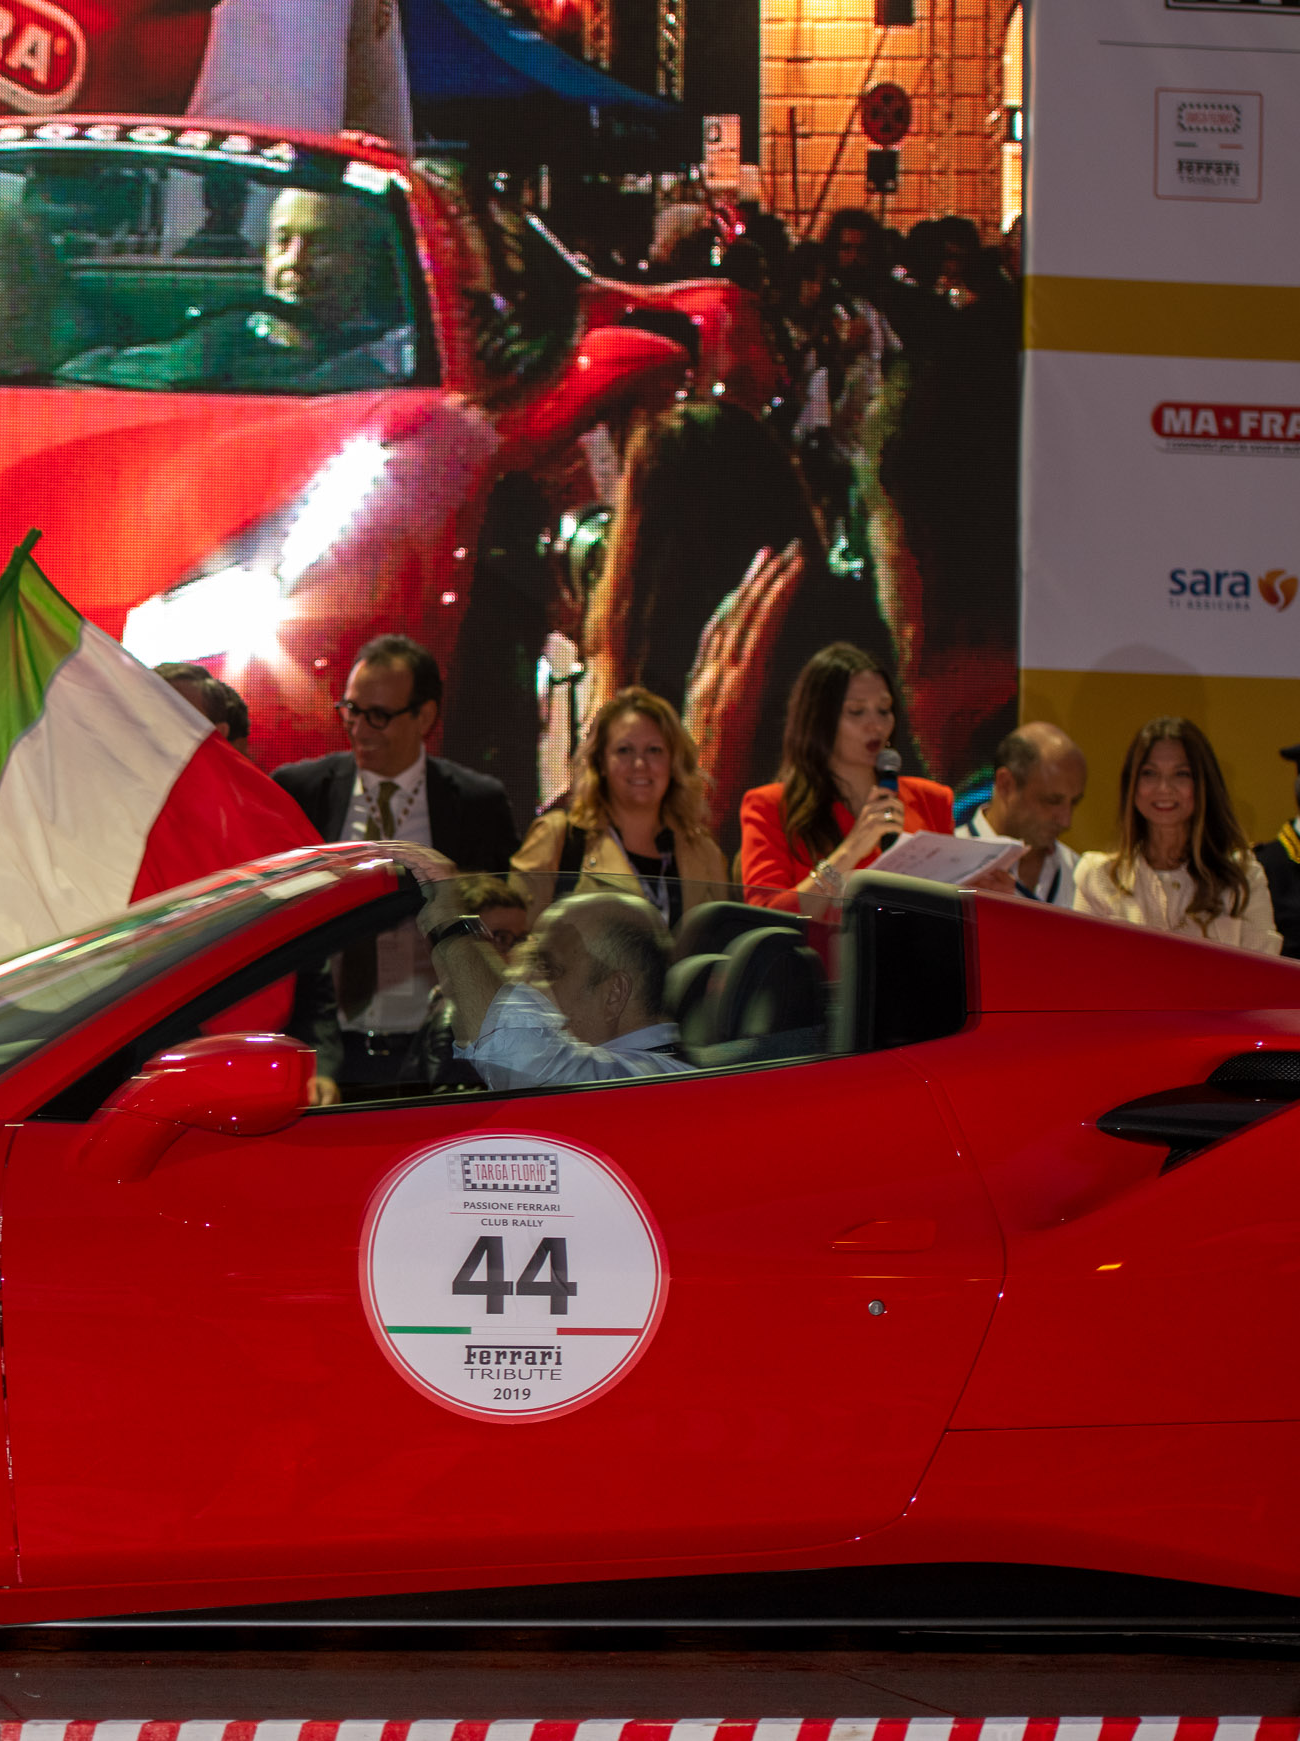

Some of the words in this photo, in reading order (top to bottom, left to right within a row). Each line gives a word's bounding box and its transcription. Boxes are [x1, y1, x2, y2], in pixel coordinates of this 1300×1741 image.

[1169, 568, 1251, 598] sara
[474, 1163, 509, 1181] TARGA
[510, 1163, 547, 1182] FLORIO
[463, 1201, 514, 1211] PASSIONE
[517, 1202, 561, 1212] FERRARI
[481, 1218, 509, 1227] CLUB
[512, 1219, 544, 1228] RALLY
[452, 1235, 578, 1315] 44
[464, 1345, 562, 1366] Ferrari
[463, 1368, 562, 1381] TRIBUTE
[493, 1387, 532, 1401] 2019
